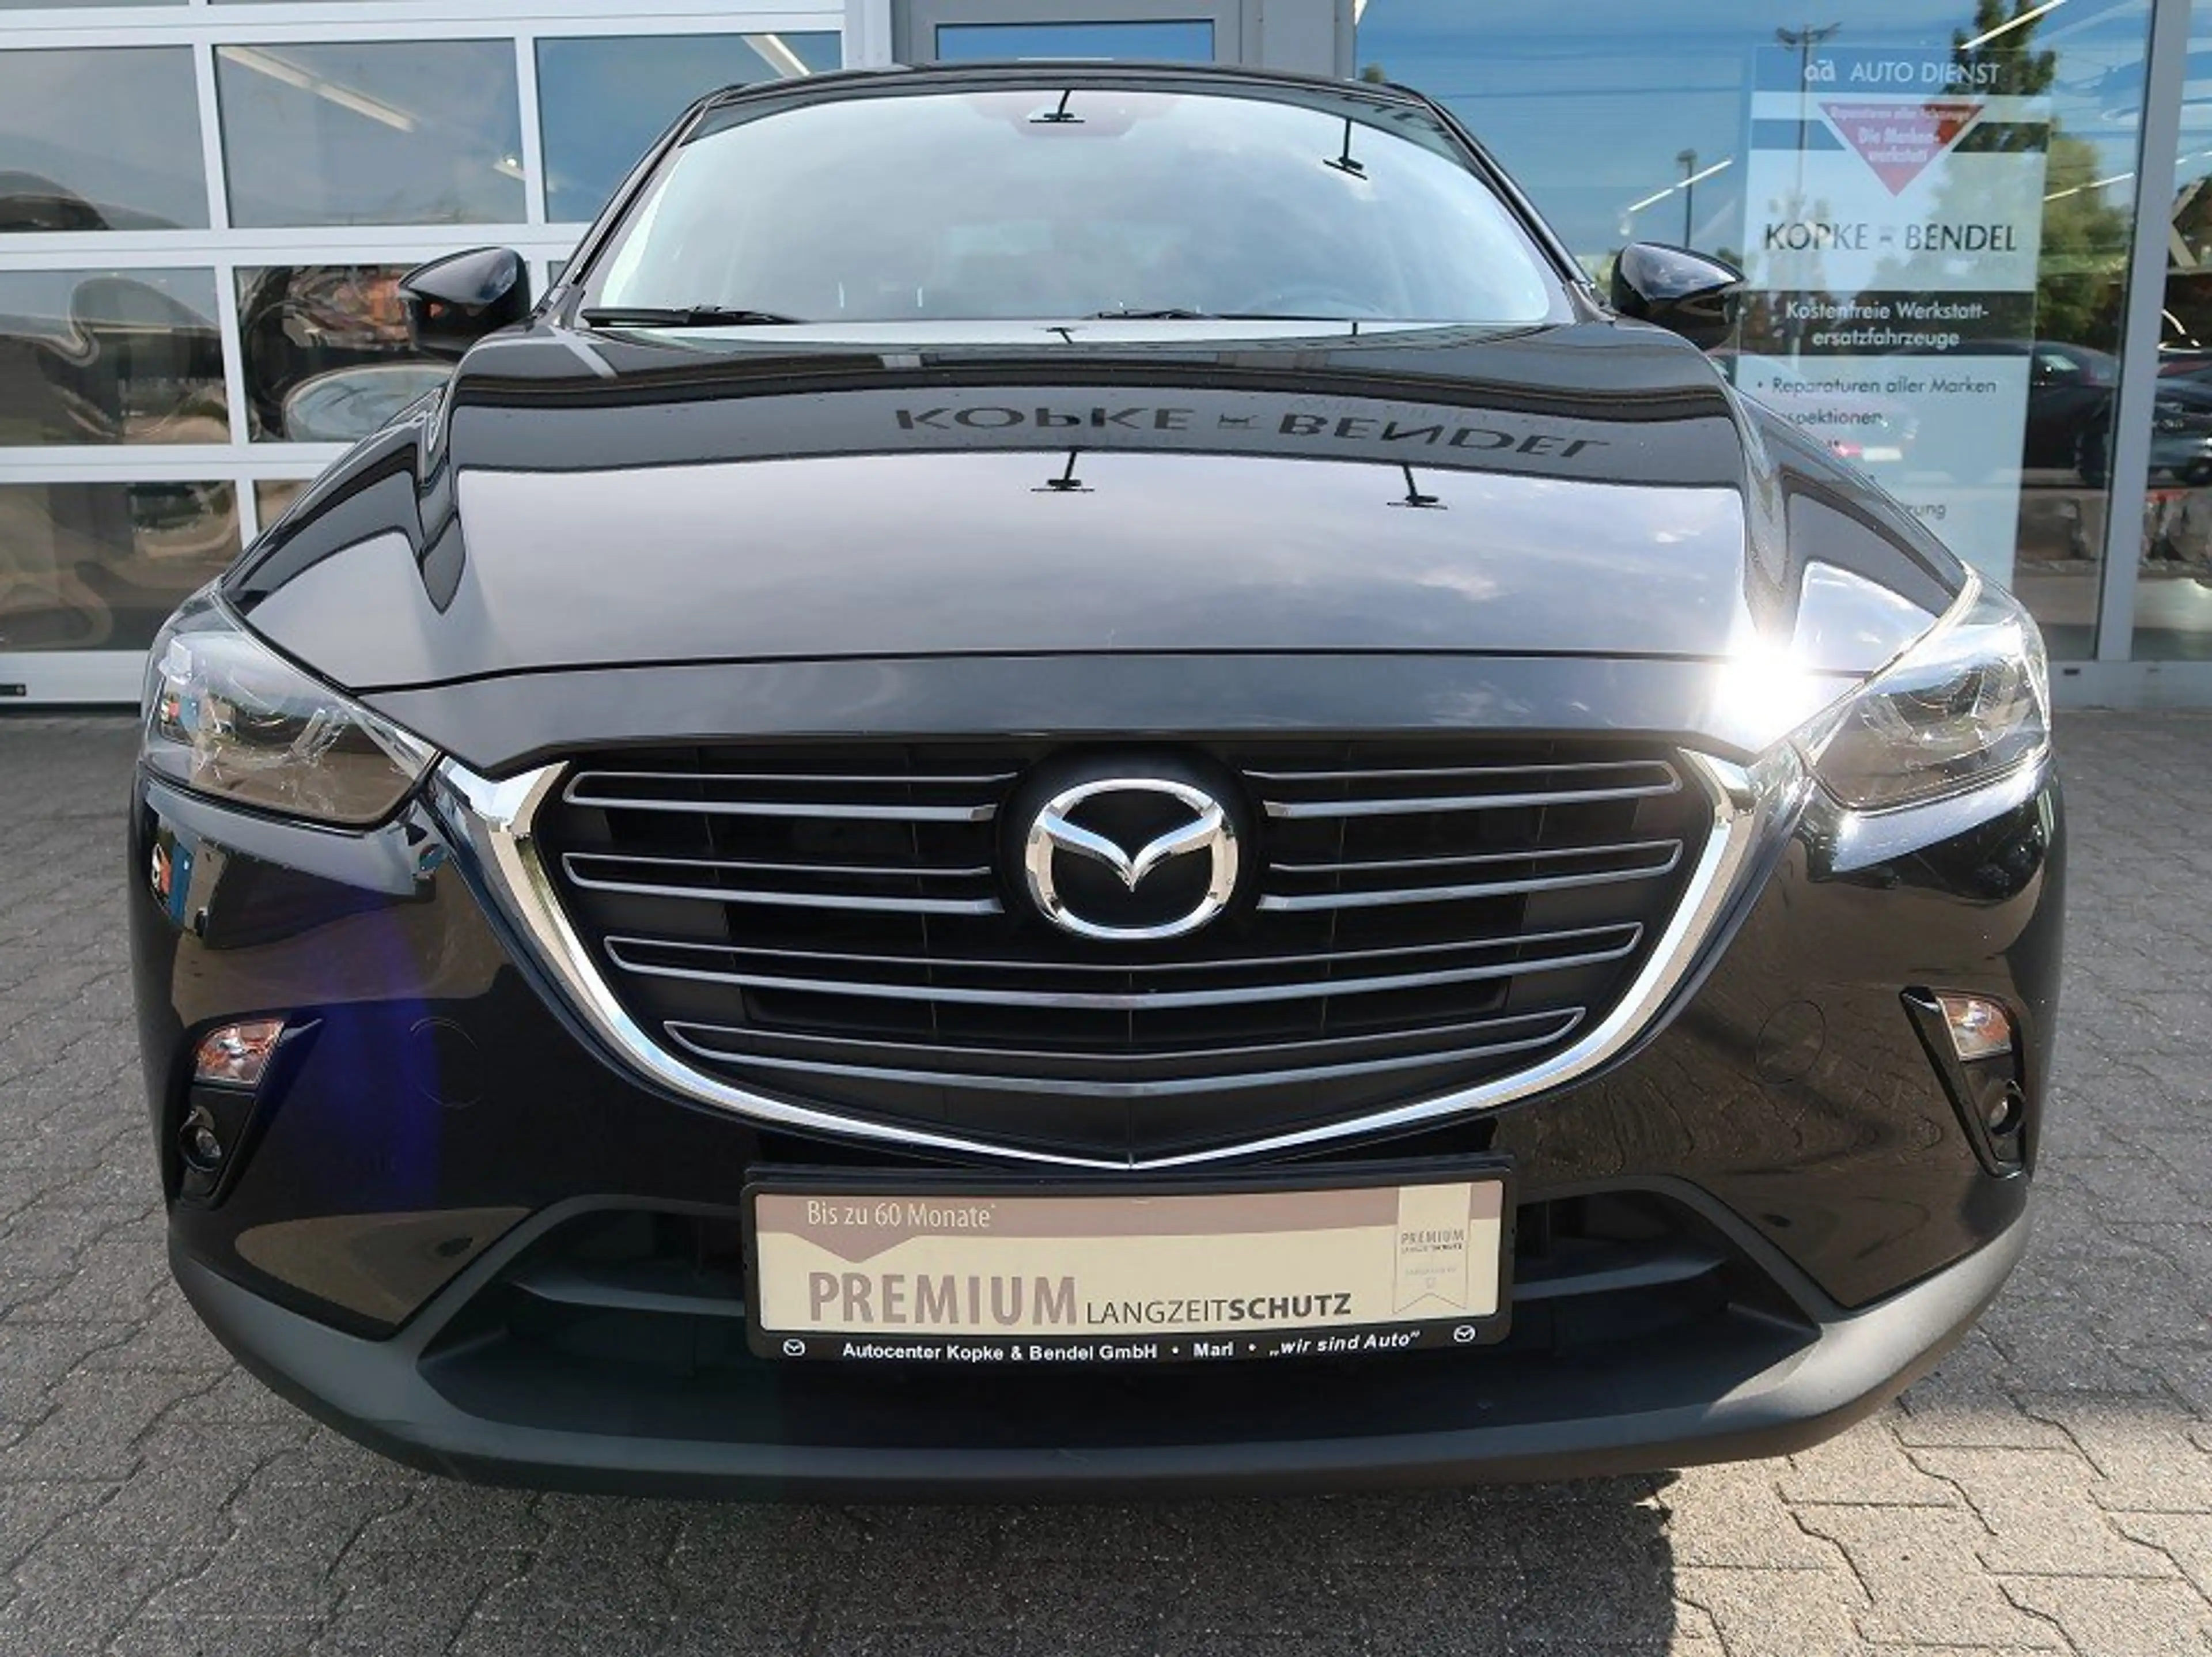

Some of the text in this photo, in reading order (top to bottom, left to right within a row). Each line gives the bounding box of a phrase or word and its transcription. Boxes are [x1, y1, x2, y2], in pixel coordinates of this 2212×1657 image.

[1850, 62, 1914, 82] AUTO
[1921, 63, 2001, 84] DIENST
[1764, 223, 2016, 251] KOPKE BENDEL
[1786, 301, 1989, 320] Kostenfreie Werkstatt-
[1812, 327, 1960, 347] ersatzfahrzeuge
[1772, 378, 1997, 398] Reparaturen aller Marken
[808, 1201, 838, 1225] Bis
[844, 1208, 868, 1225] zu
[876, 1204, 900, 1225] 60
[809, 1272, 1352, 1325] PREMIUM LANGZEITSCHUTZ
[843, 1343, 941, 1361] Autocenter
[946, 1344, 1004, 1363] Kopke
[1011, 1345, 1023, 1361] &
[1030, 1344, 1093, 1361] Bendel
[1099, 1342, 1157, 1360] GmbH
[1194, 1342, 1233, 1357] Marl
[1317, 1334, 1359, 1351] sind
